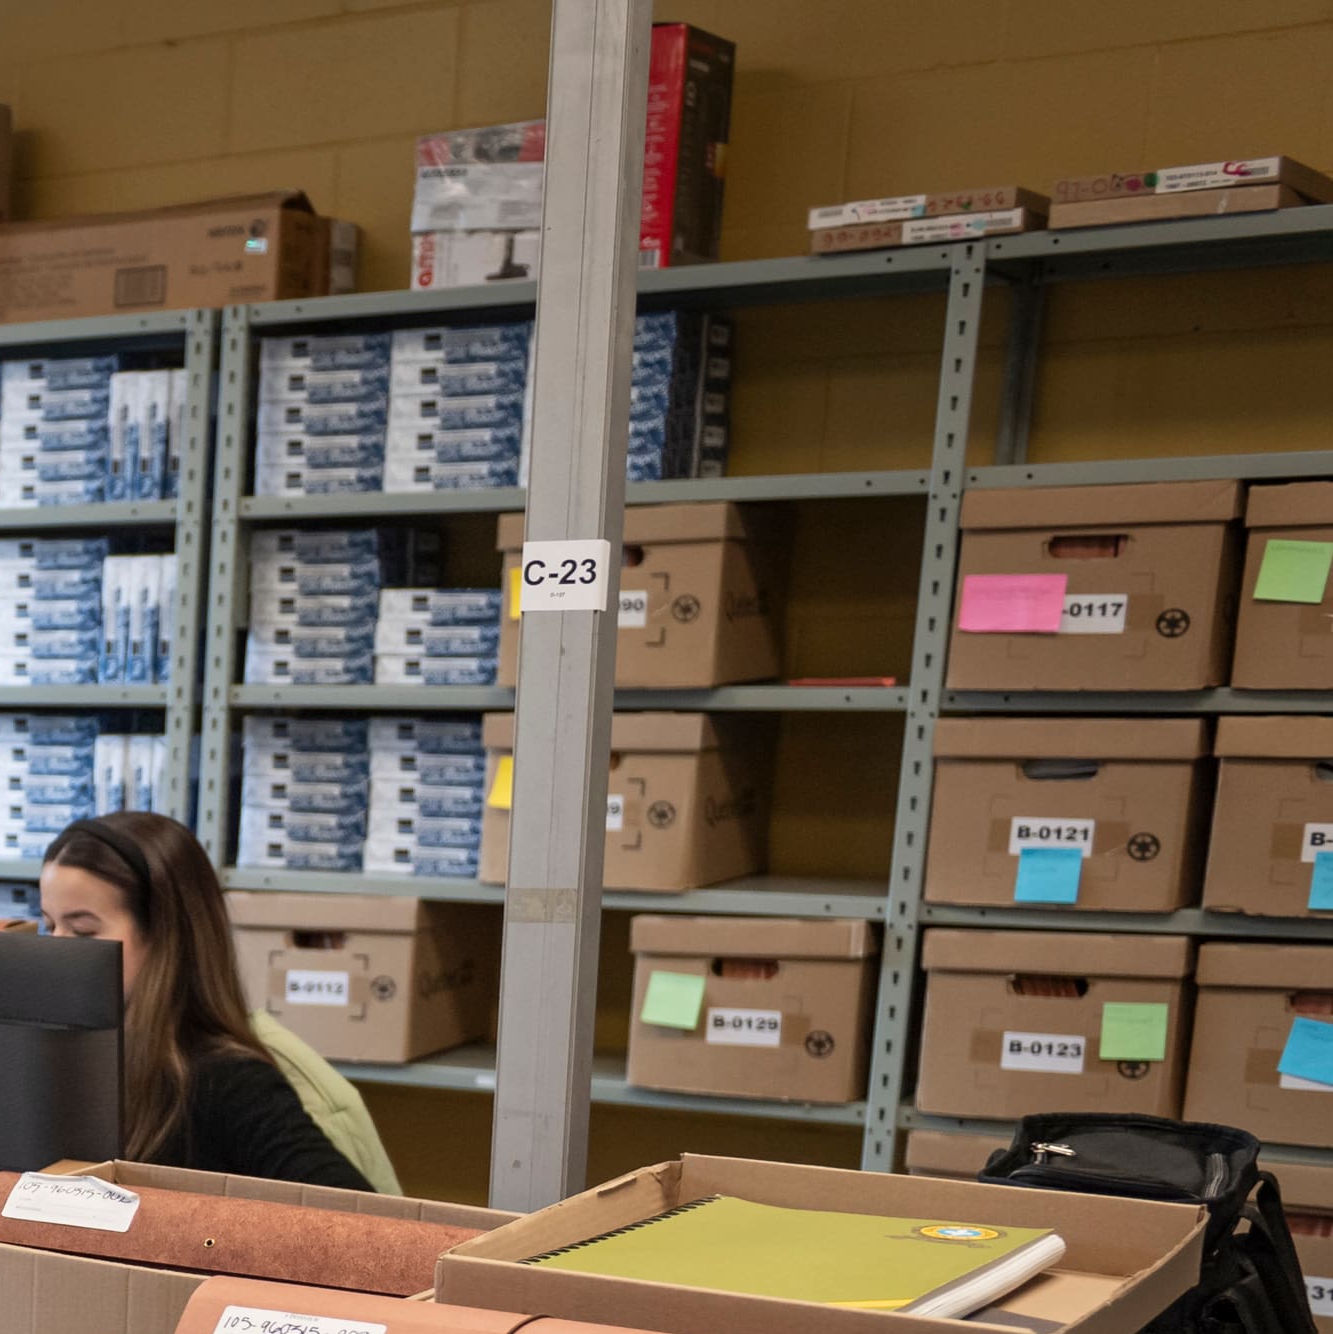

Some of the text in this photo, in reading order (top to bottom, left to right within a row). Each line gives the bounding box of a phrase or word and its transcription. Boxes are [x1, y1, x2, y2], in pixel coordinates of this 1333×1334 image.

[524, 558, 597, 586] C-23
[1017, 824, 1090, 841] B-0121
[1009, 1040, 1082, 1058] B-0123
